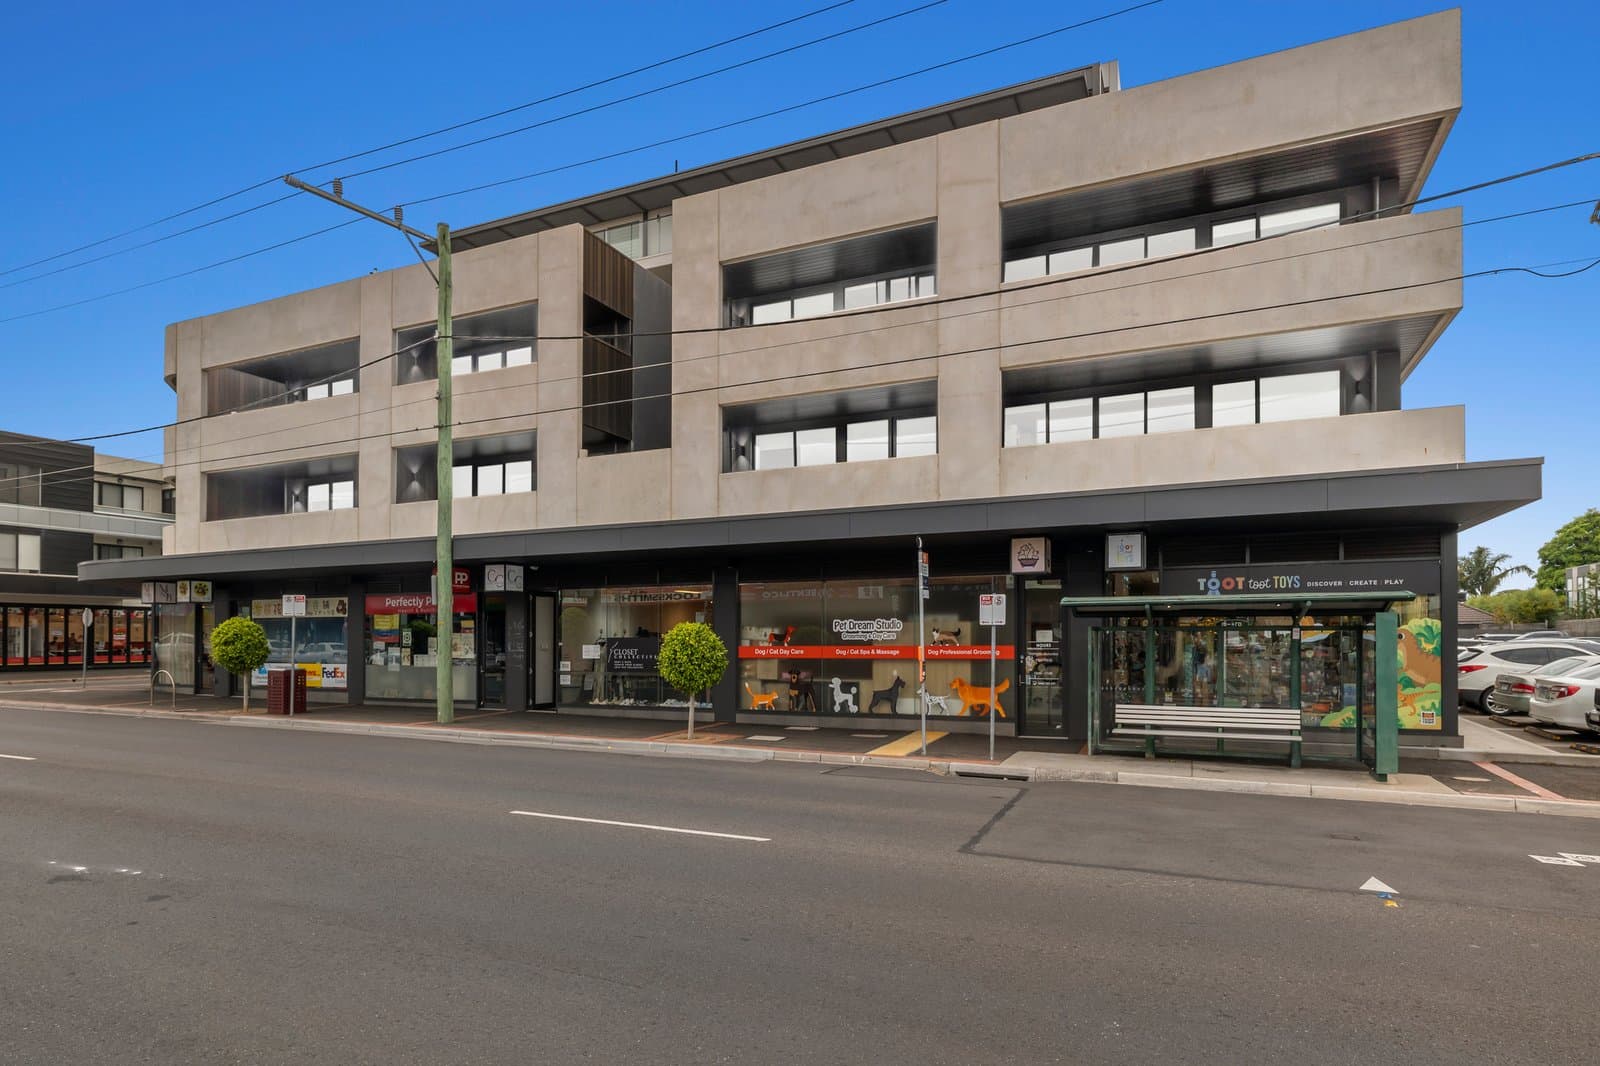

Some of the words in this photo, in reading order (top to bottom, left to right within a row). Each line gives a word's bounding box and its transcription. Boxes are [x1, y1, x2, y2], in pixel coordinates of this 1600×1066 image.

[1197, 572, 1245, 594] TOOT
[1247, 577, 1272, 590] toot
[1272, 575, 1301, 589] TOYS
[385, 596, 424, 608] Perfectly
[833, 619, 848, 632] Pet
[848, 619, 875, 631] Dream
[875, 618, 903, 631] Studio
[872, 632, 883, 641] Day
[754, 648, 766, 656] Dog
[779, 648, 790, 656] Day
[973, 648, 1000, 656] Groomg
[322, 667, 345, 679] FedEx
